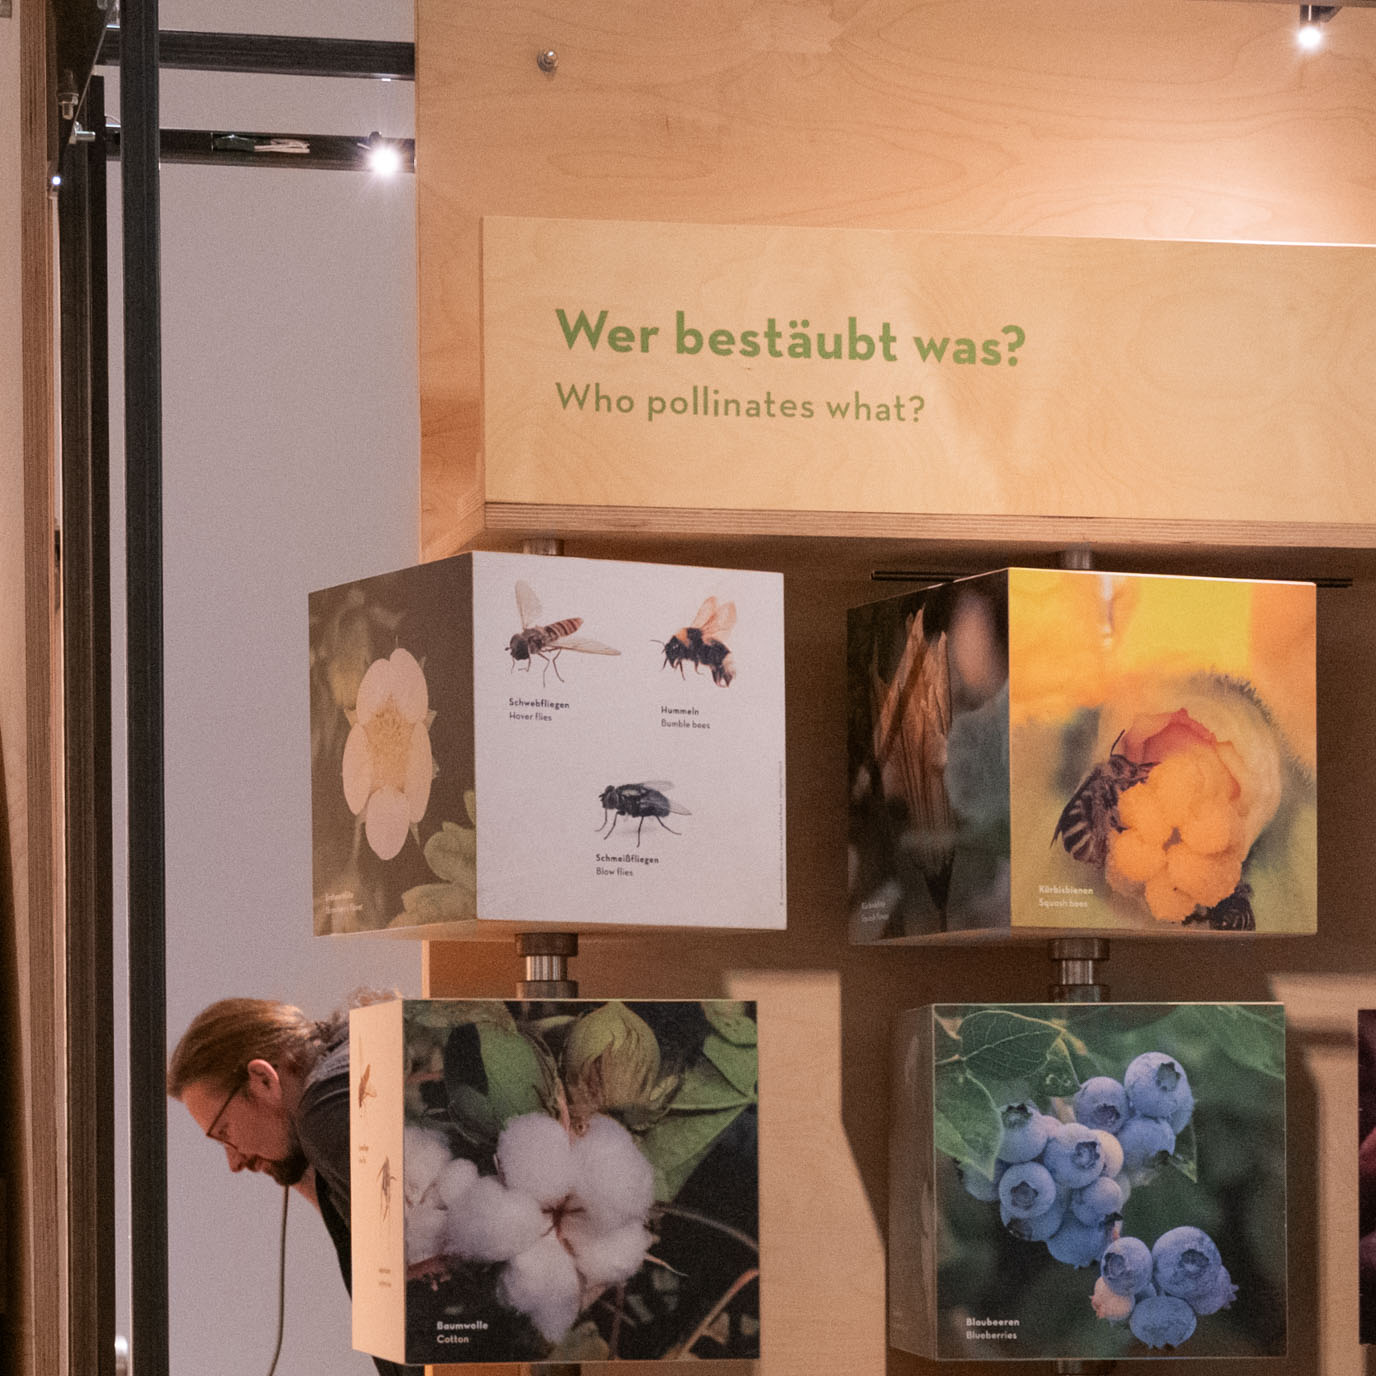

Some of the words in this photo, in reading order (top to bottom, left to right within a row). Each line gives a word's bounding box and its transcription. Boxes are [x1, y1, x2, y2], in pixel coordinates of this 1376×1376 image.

[555, 309, 660, 354] Wer
[675, 312, 899, 361] bestäubt
[913, 323, 1027, 367] was?
[555, 382, 635, 415] Who
[648, 386, 814, 423] pollinates
[825, 389, 925, 423] what?
[508, 699, 570, 709] Schwebfliegen
[660, 706, 700, 714] Hummeln
[508, 713, 533, 721] Hover
[534, 713, 553, 721] flies
[660, 719, 691, 728] Bumble
[595, 854, 660, 864] Schmeißfliegen
[595, 867, 615, 875] Blow
[616, 867, 634, 876] flies
[436, 1321, 489, 1330] Baumwolle
[965, 1318, 1020, 1326] Blaubeeren
[436, 1334, 470, 1343] Cotton
[965, 1331, 1018, 1339] Blueberries
